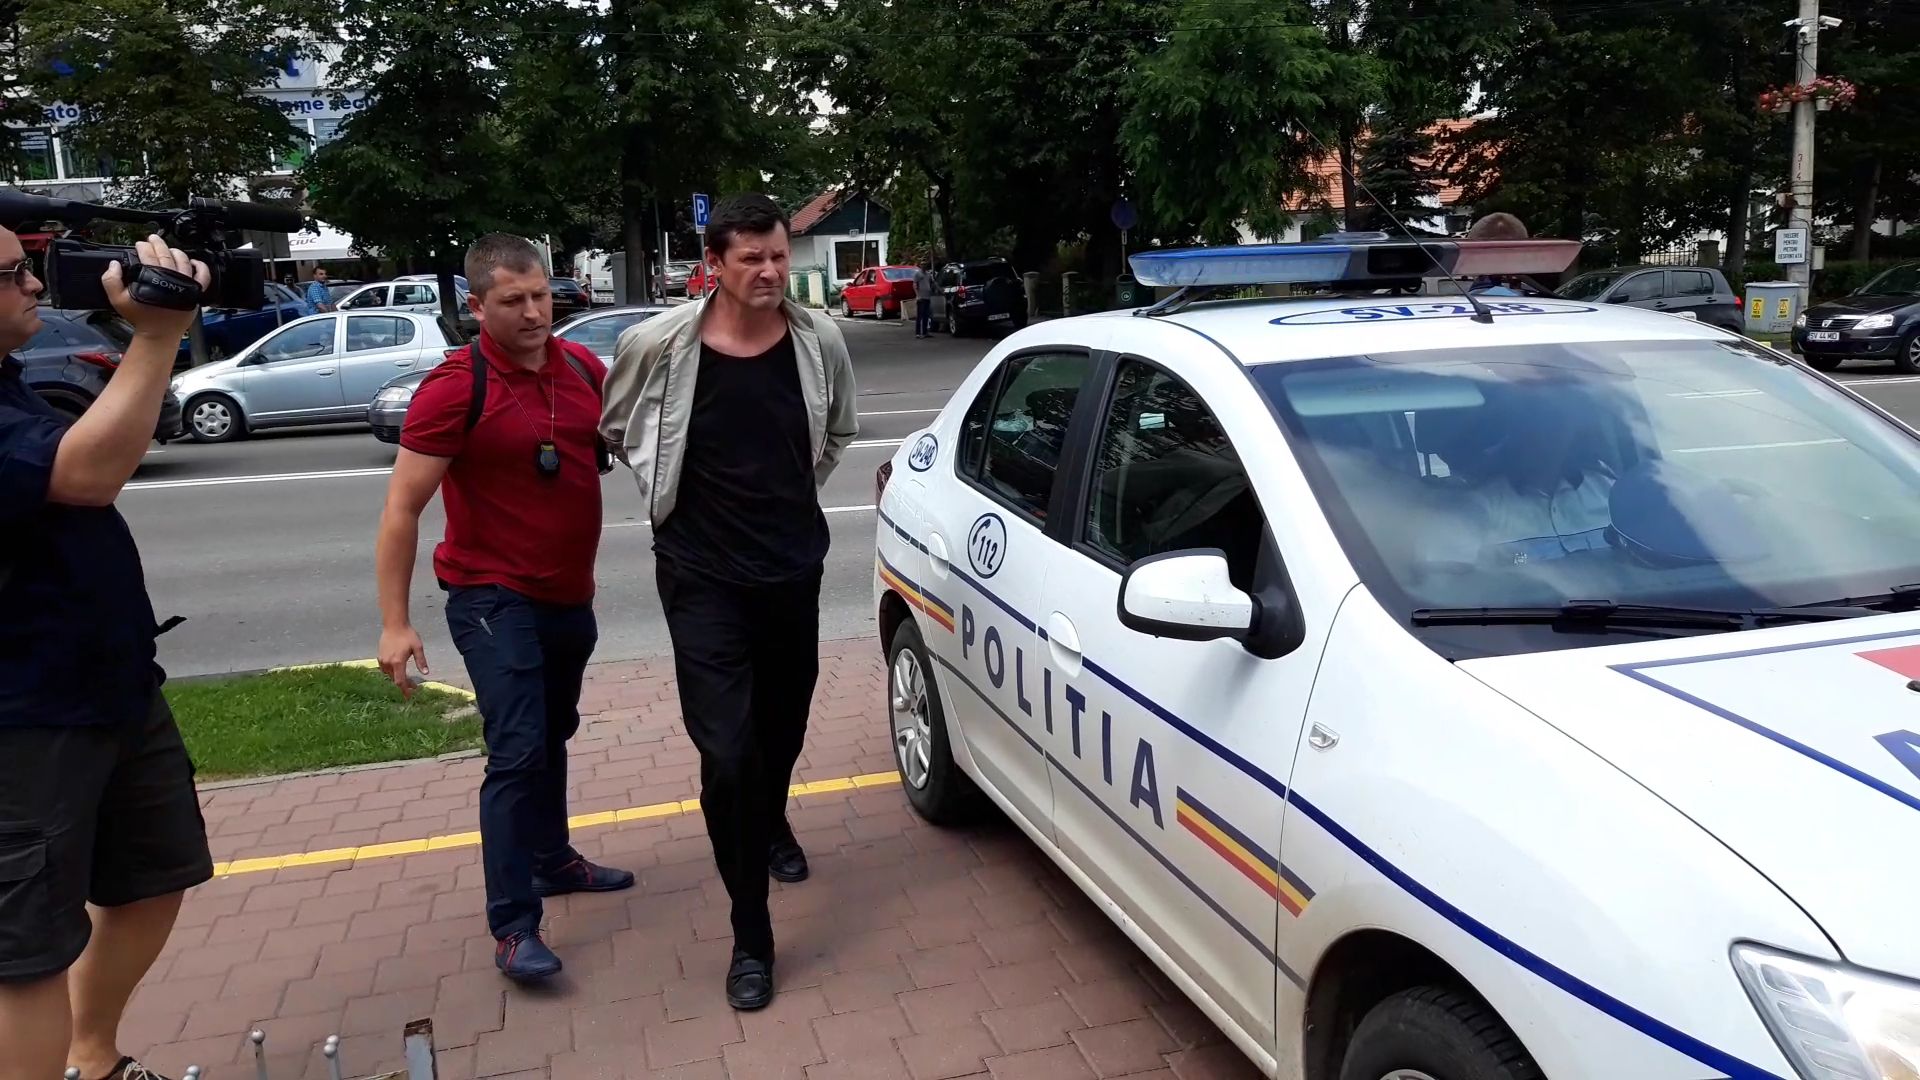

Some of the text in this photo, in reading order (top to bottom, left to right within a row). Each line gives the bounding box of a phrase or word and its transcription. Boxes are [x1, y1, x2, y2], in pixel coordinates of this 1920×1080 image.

[152, 277, 185, 293] SONY
[977, 535, 998, 571] 112
[962, 603, 1164, 830] POLITIA
